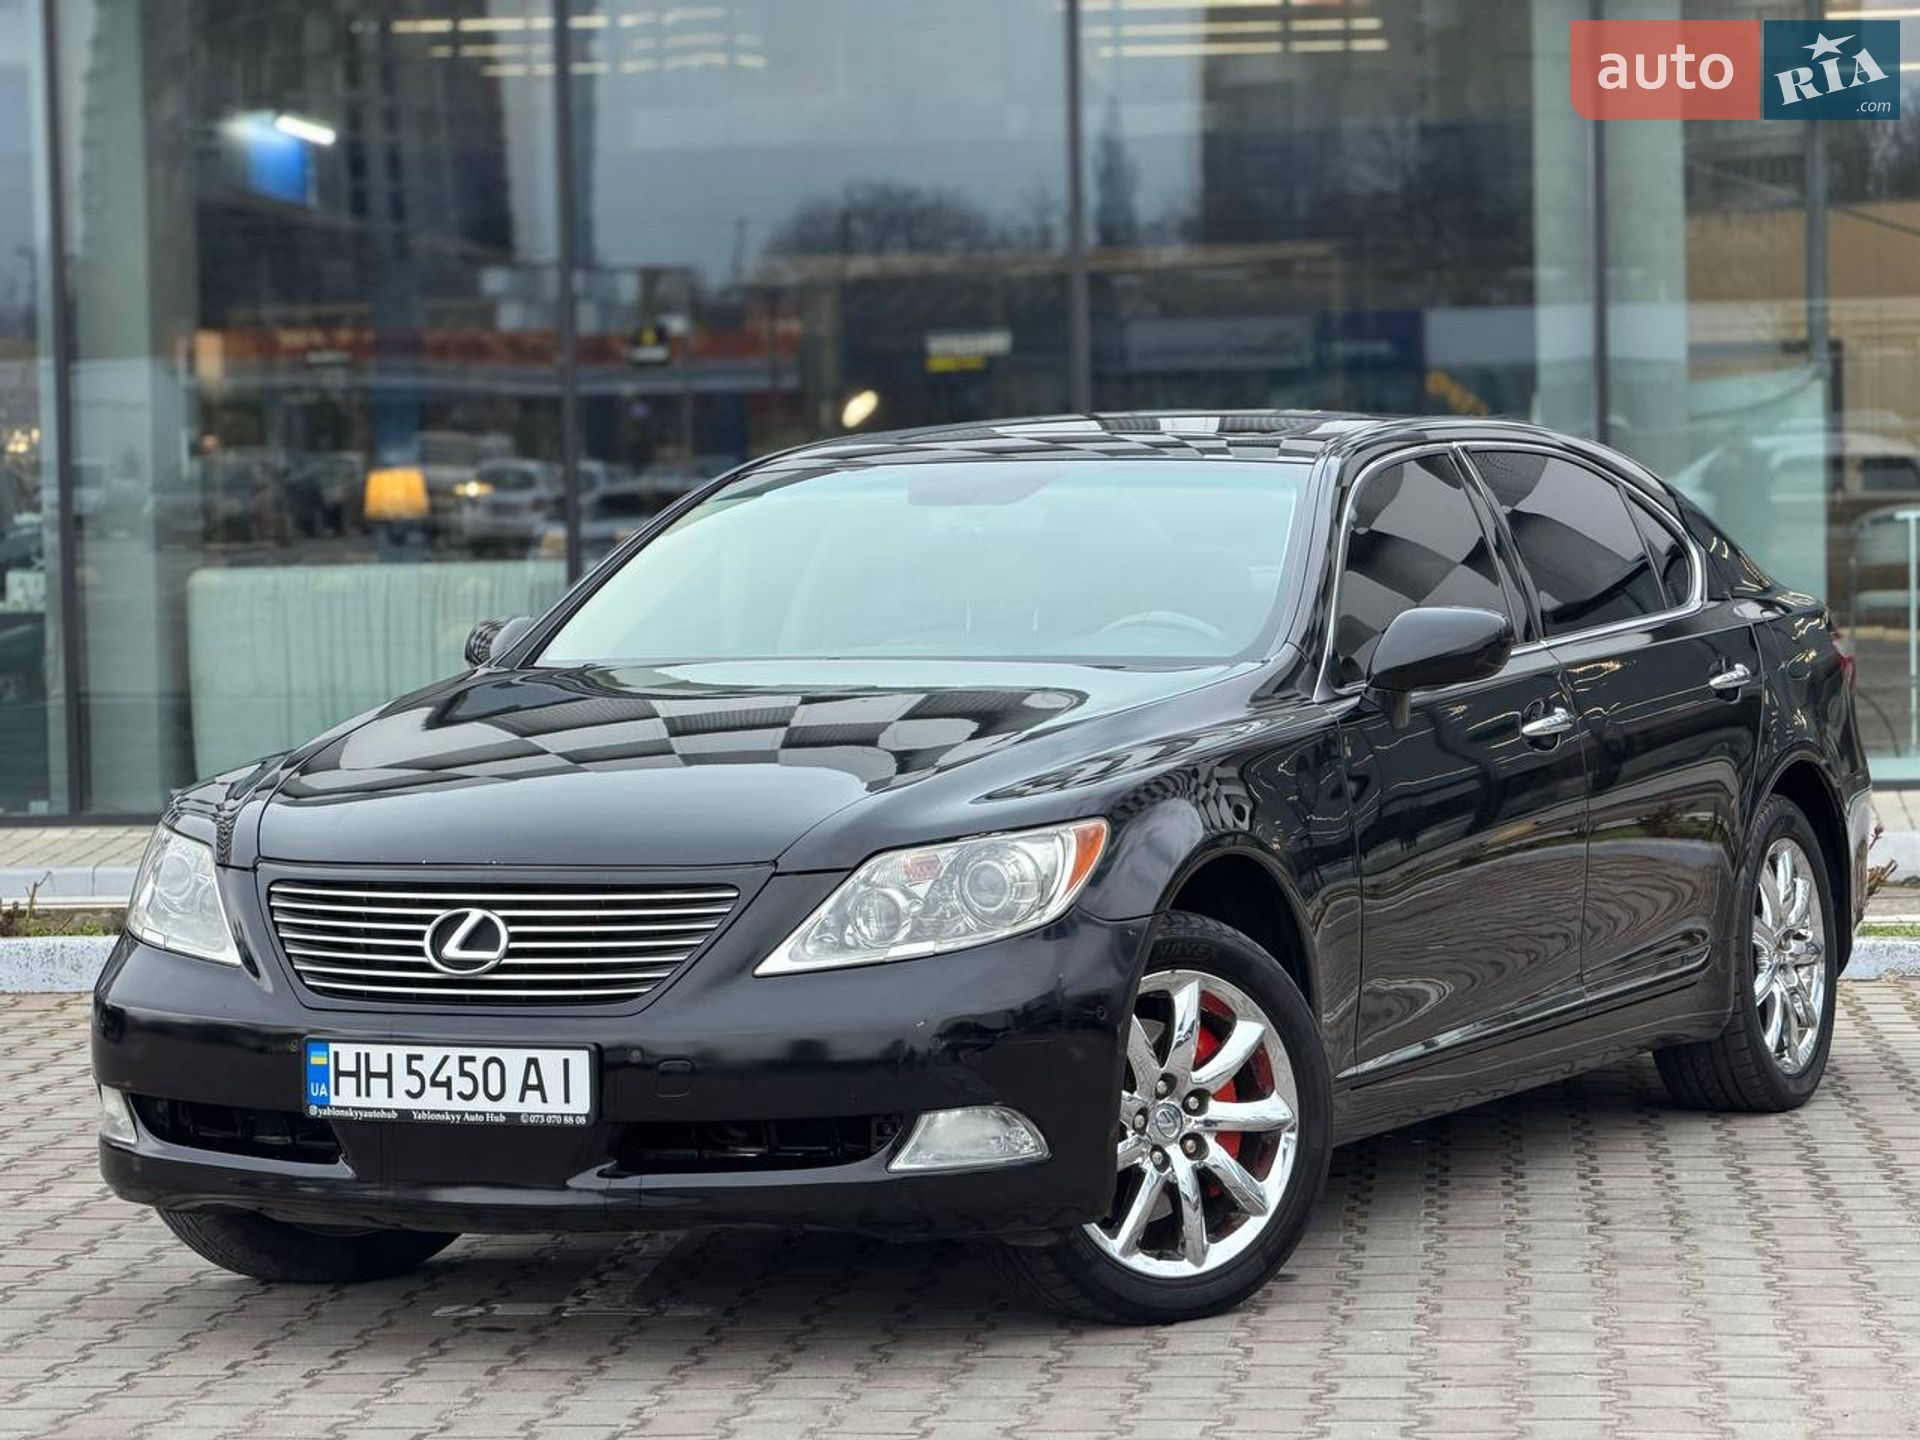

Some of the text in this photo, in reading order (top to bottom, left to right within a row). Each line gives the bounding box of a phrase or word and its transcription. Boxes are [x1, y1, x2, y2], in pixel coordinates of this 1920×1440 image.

[332, 1050, 571, 1105] HH 5450 AI
[310, 1081, 328, 1098] UA
[463, 1112, 485, 1122] Auto
[486, 1112, 506, 1122] Hub
